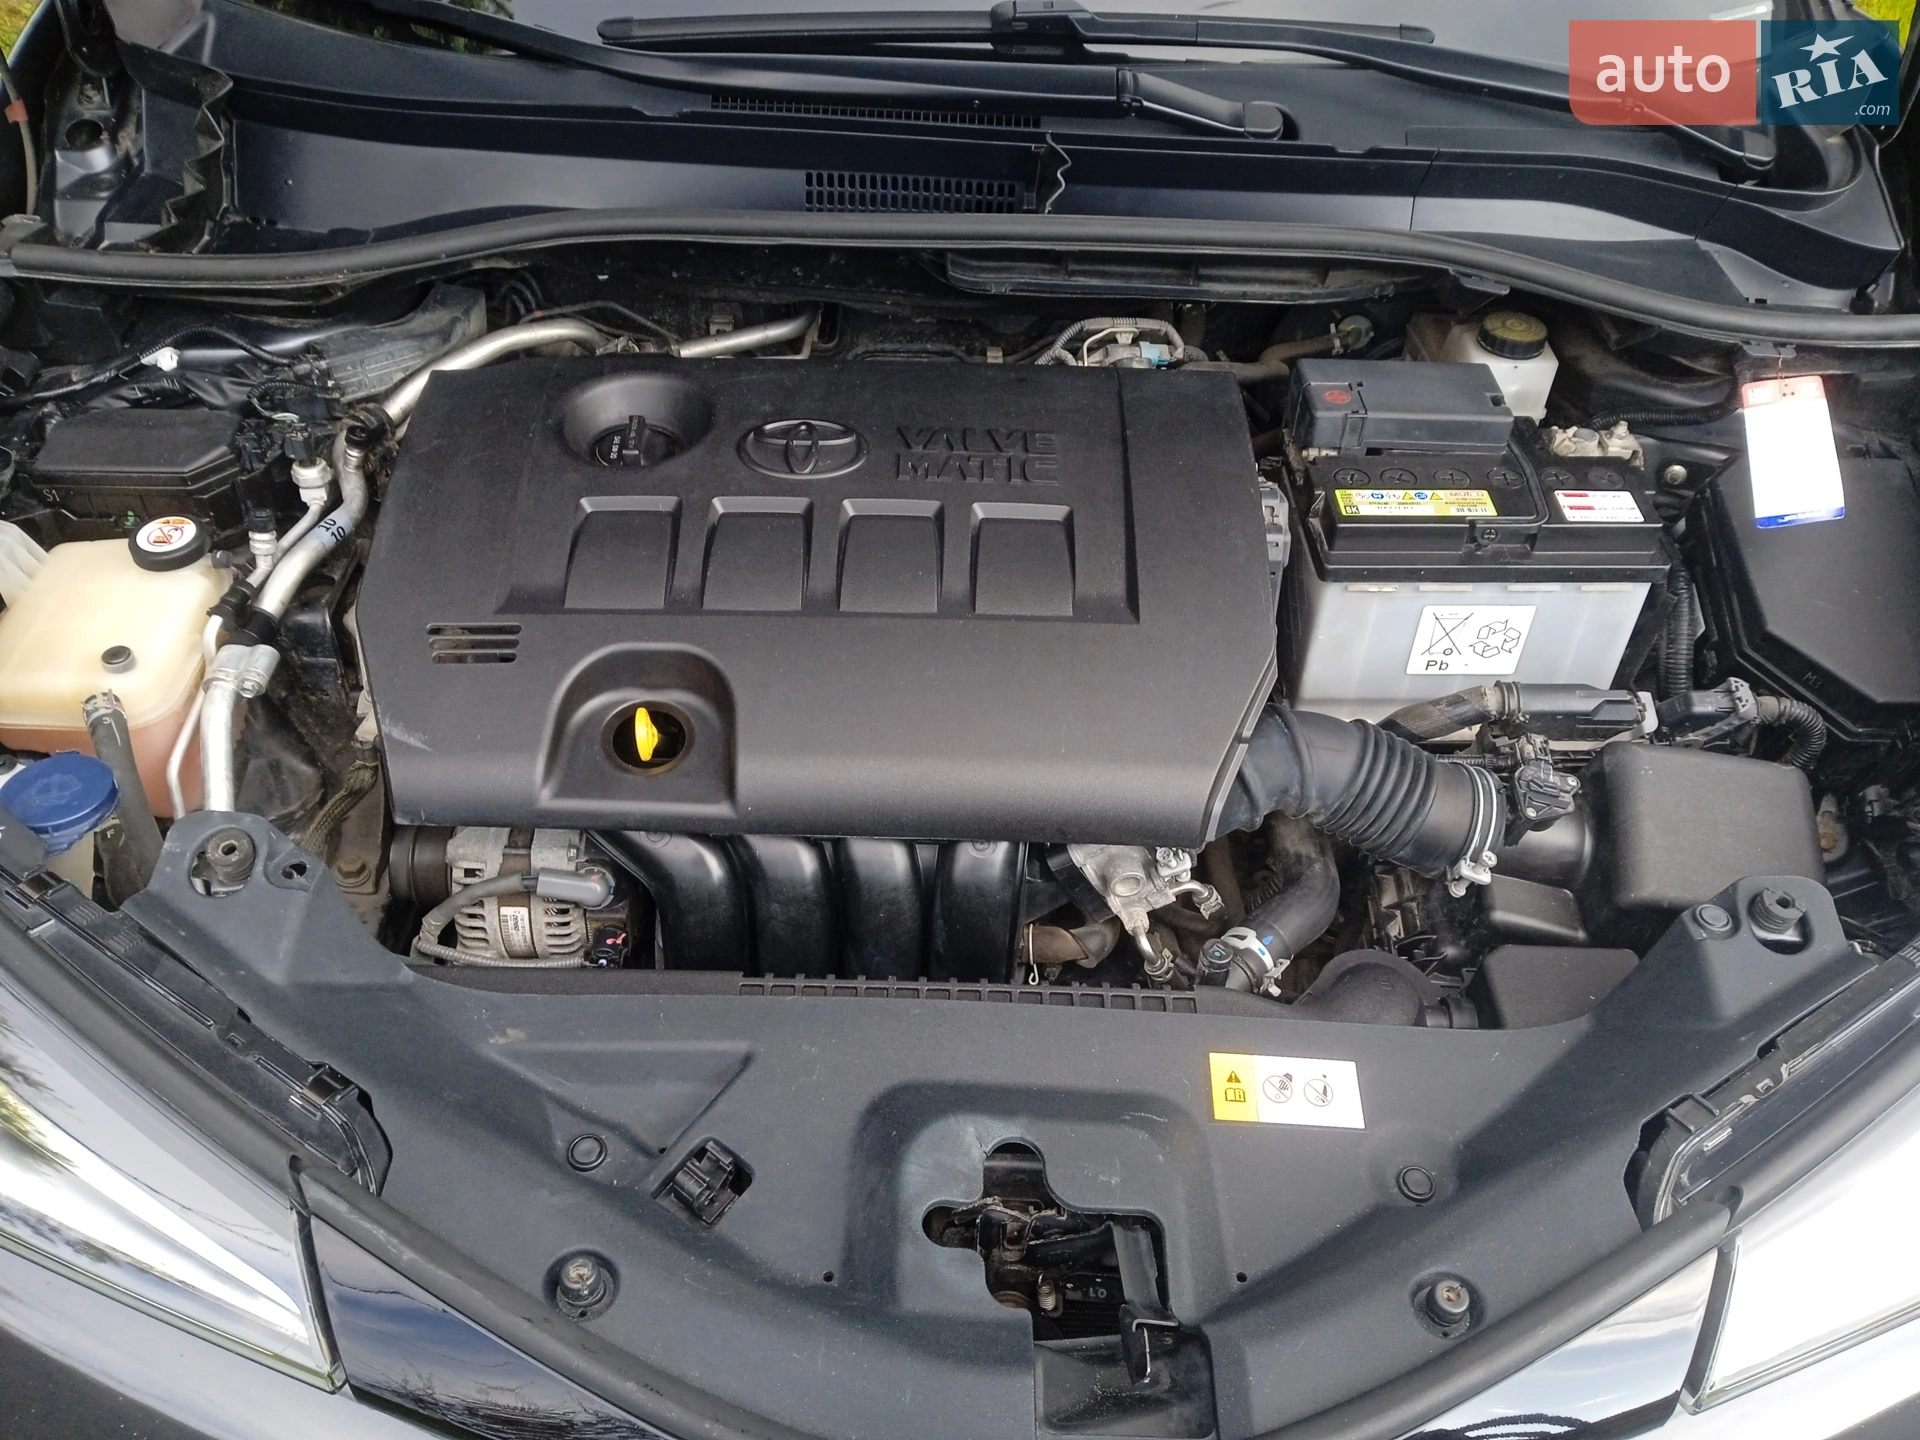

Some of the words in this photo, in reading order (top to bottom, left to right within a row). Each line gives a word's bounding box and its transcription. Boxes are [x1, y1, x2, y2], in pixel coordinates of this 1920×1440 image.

[896, 425, 1057, 455] VALVE
[897, 453, 1059, 486] MATIC
[318, 518, 337, 532] 10
[331, 525, 346, 543] 10
[1425, 660, 1449, 671] Pb
